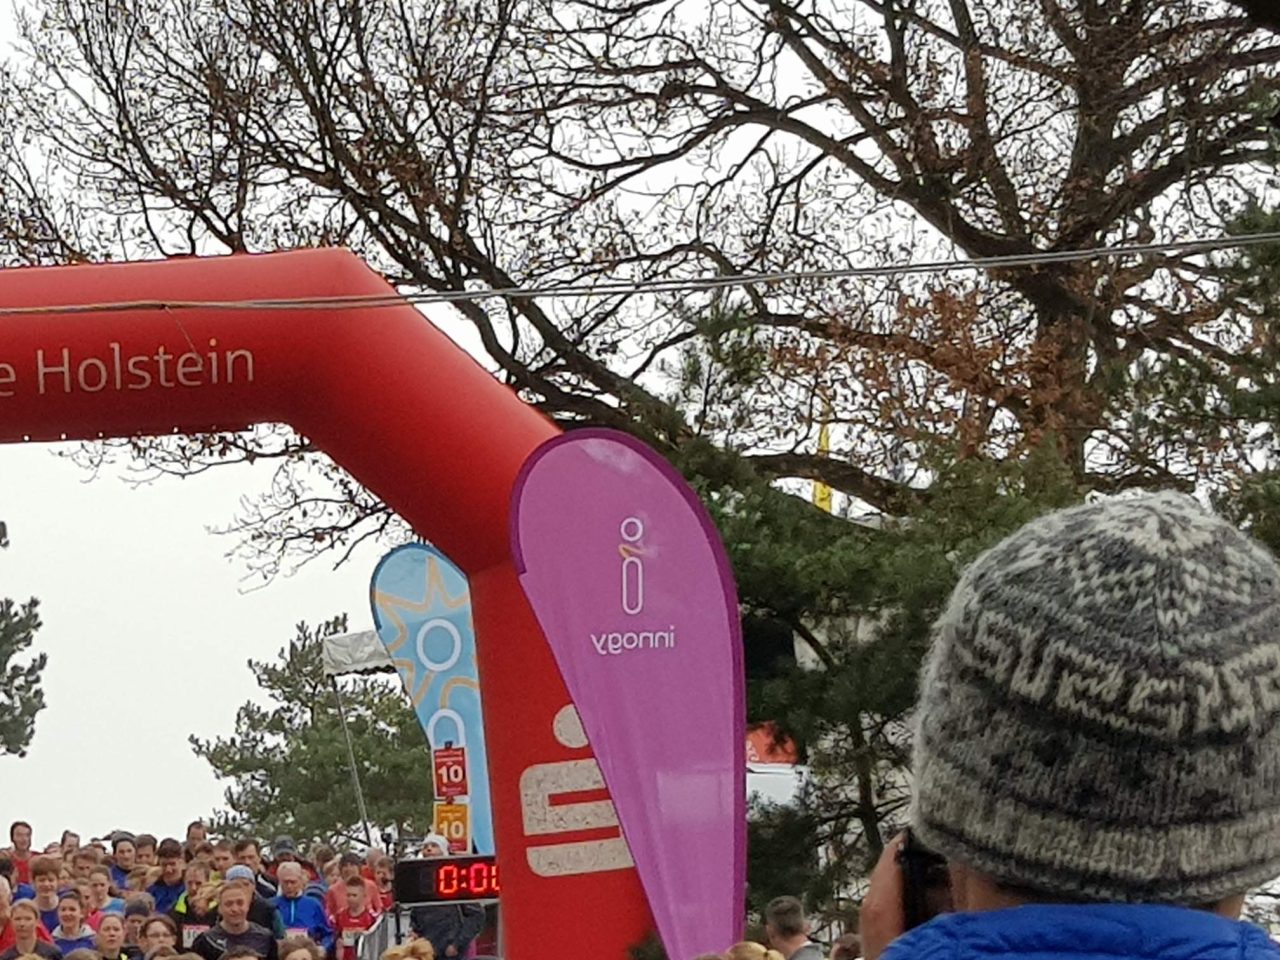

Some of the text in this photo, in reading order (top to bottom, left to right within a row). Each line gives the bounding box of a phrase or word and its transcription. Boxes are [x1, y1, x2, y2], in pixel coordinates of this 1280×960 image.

[35, 337, 255, 395] Holstein
[437, 764, 464, 784] 10
[439, 819, 465, 839] 10
